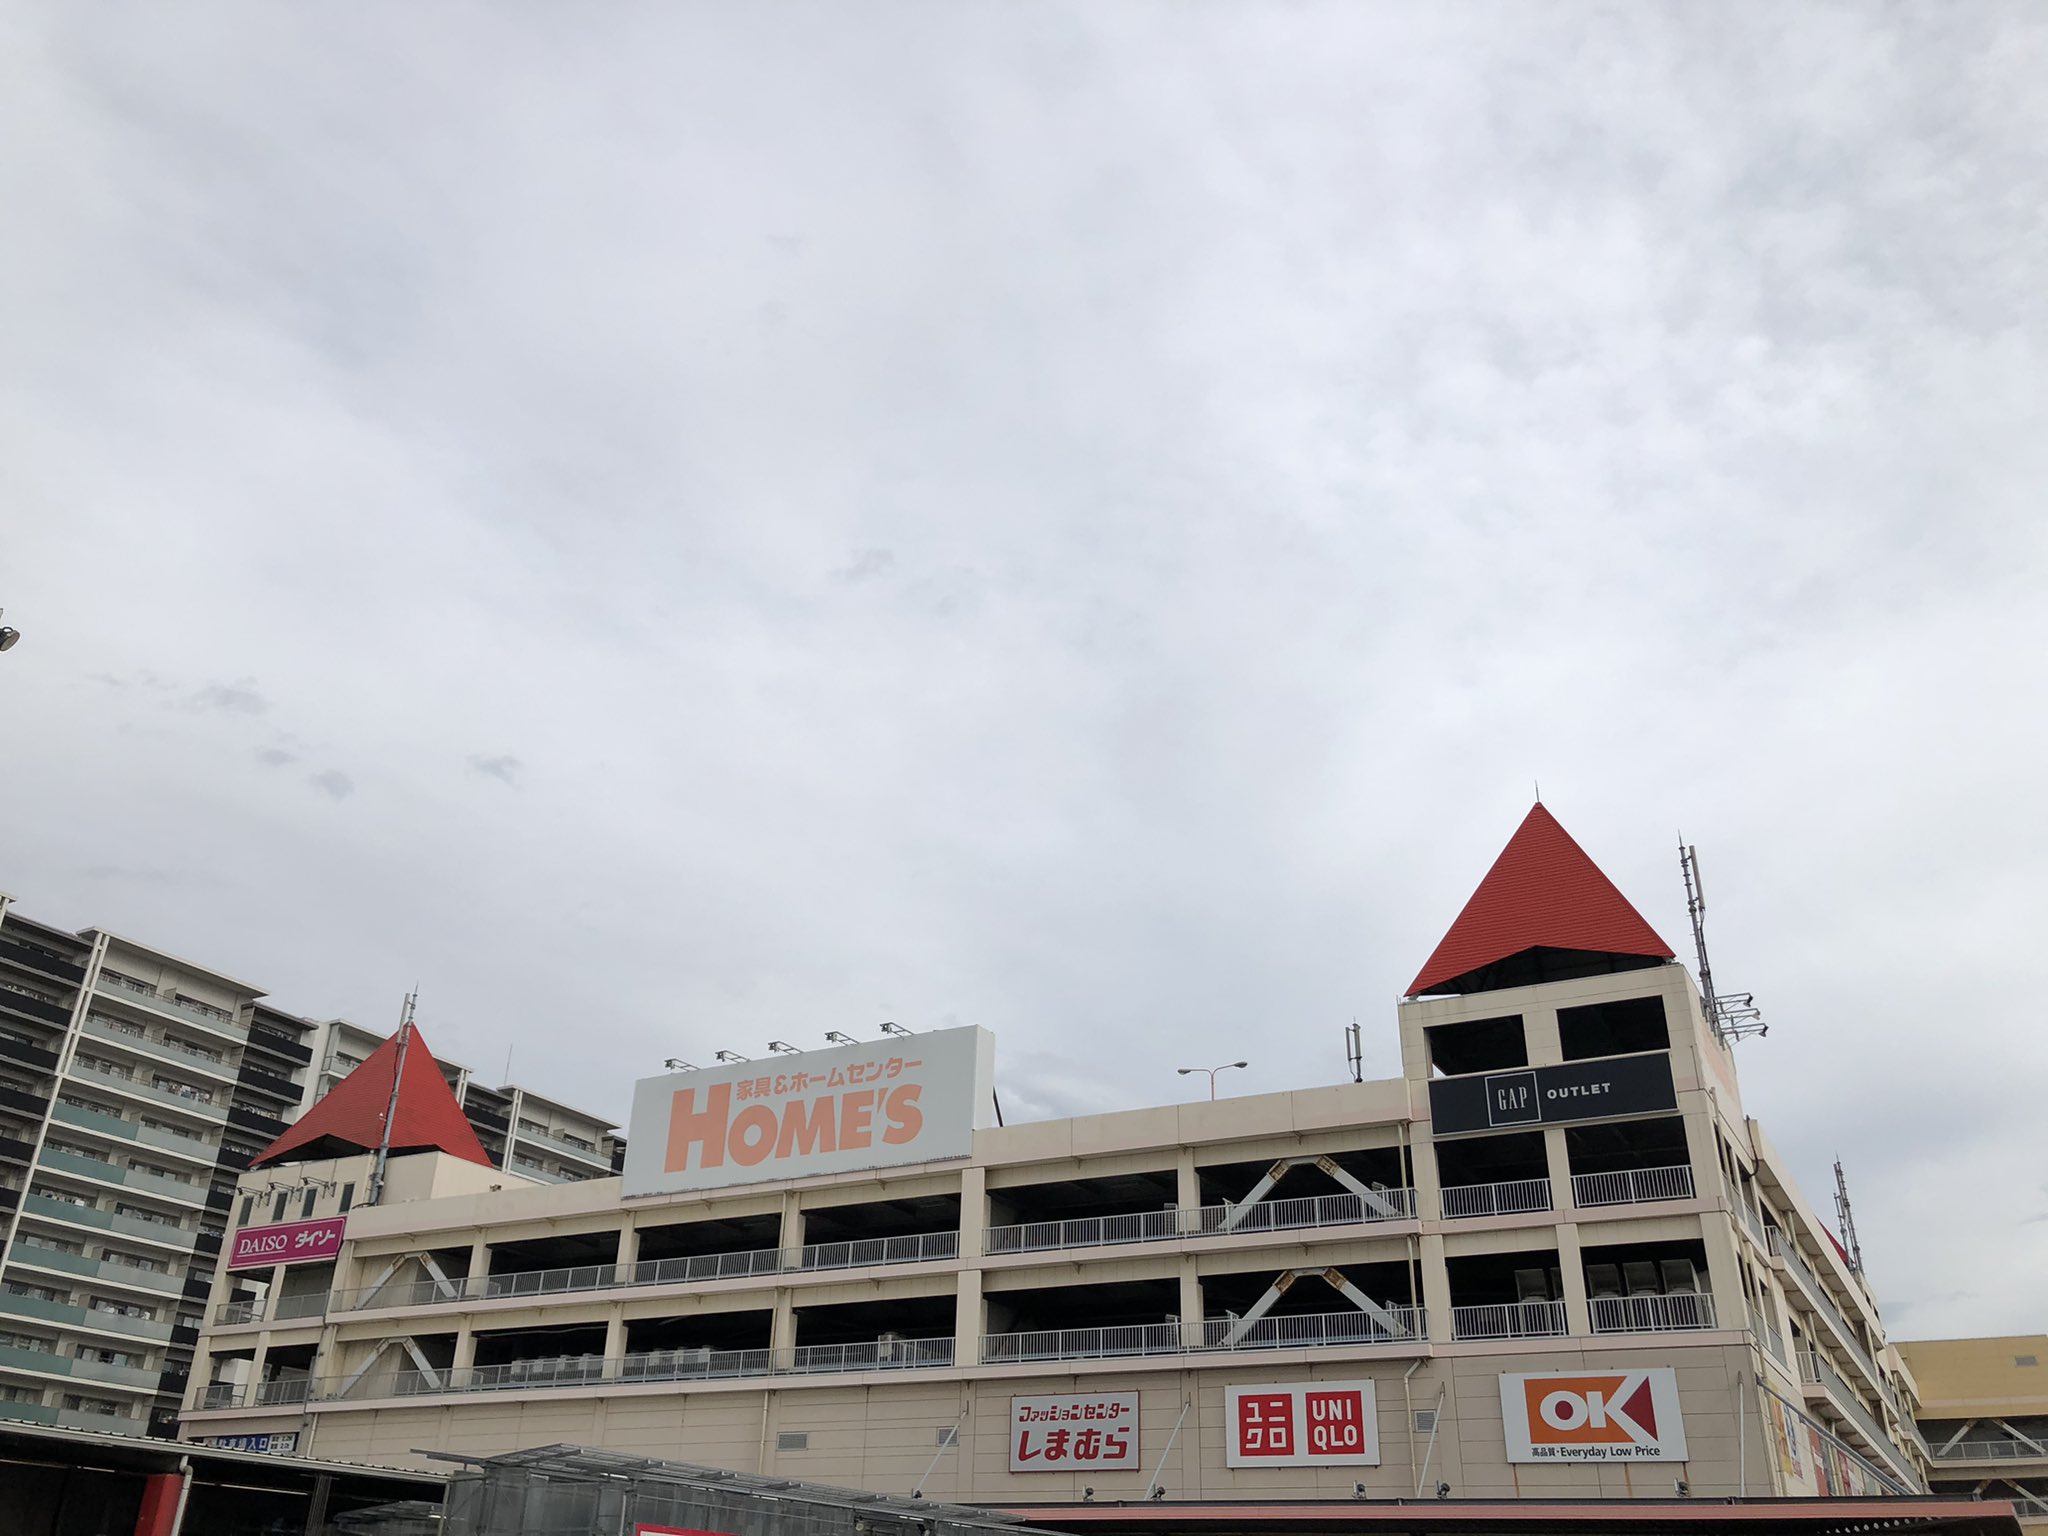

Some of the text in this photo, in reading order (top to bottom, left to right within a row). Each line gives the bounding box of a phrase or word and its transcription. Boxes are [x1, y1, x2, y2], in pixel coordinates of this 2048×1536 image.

[736, 1057, 922, 1101] 家具&ホームセンター
[1497, 1082, 1611, 1111] GAP OUTLET
[664, 1081, 924, 1174] HOME'S
[238, 1229, 336, 1254] DAISO ダイソー
[1019, 1402, 1130, 1422] ファッションセンター
[1312, 1399, 1352, 1421] UNI
[1539, 1376, 1658, 1443] OK
[1018, 1426, 1130, 1461] しまむら
[1313, 1424, 1358, 1450] QLO
[1610, 1446, 1631, 1456] Low
[1635, 1445, 1660, 1456] Price
